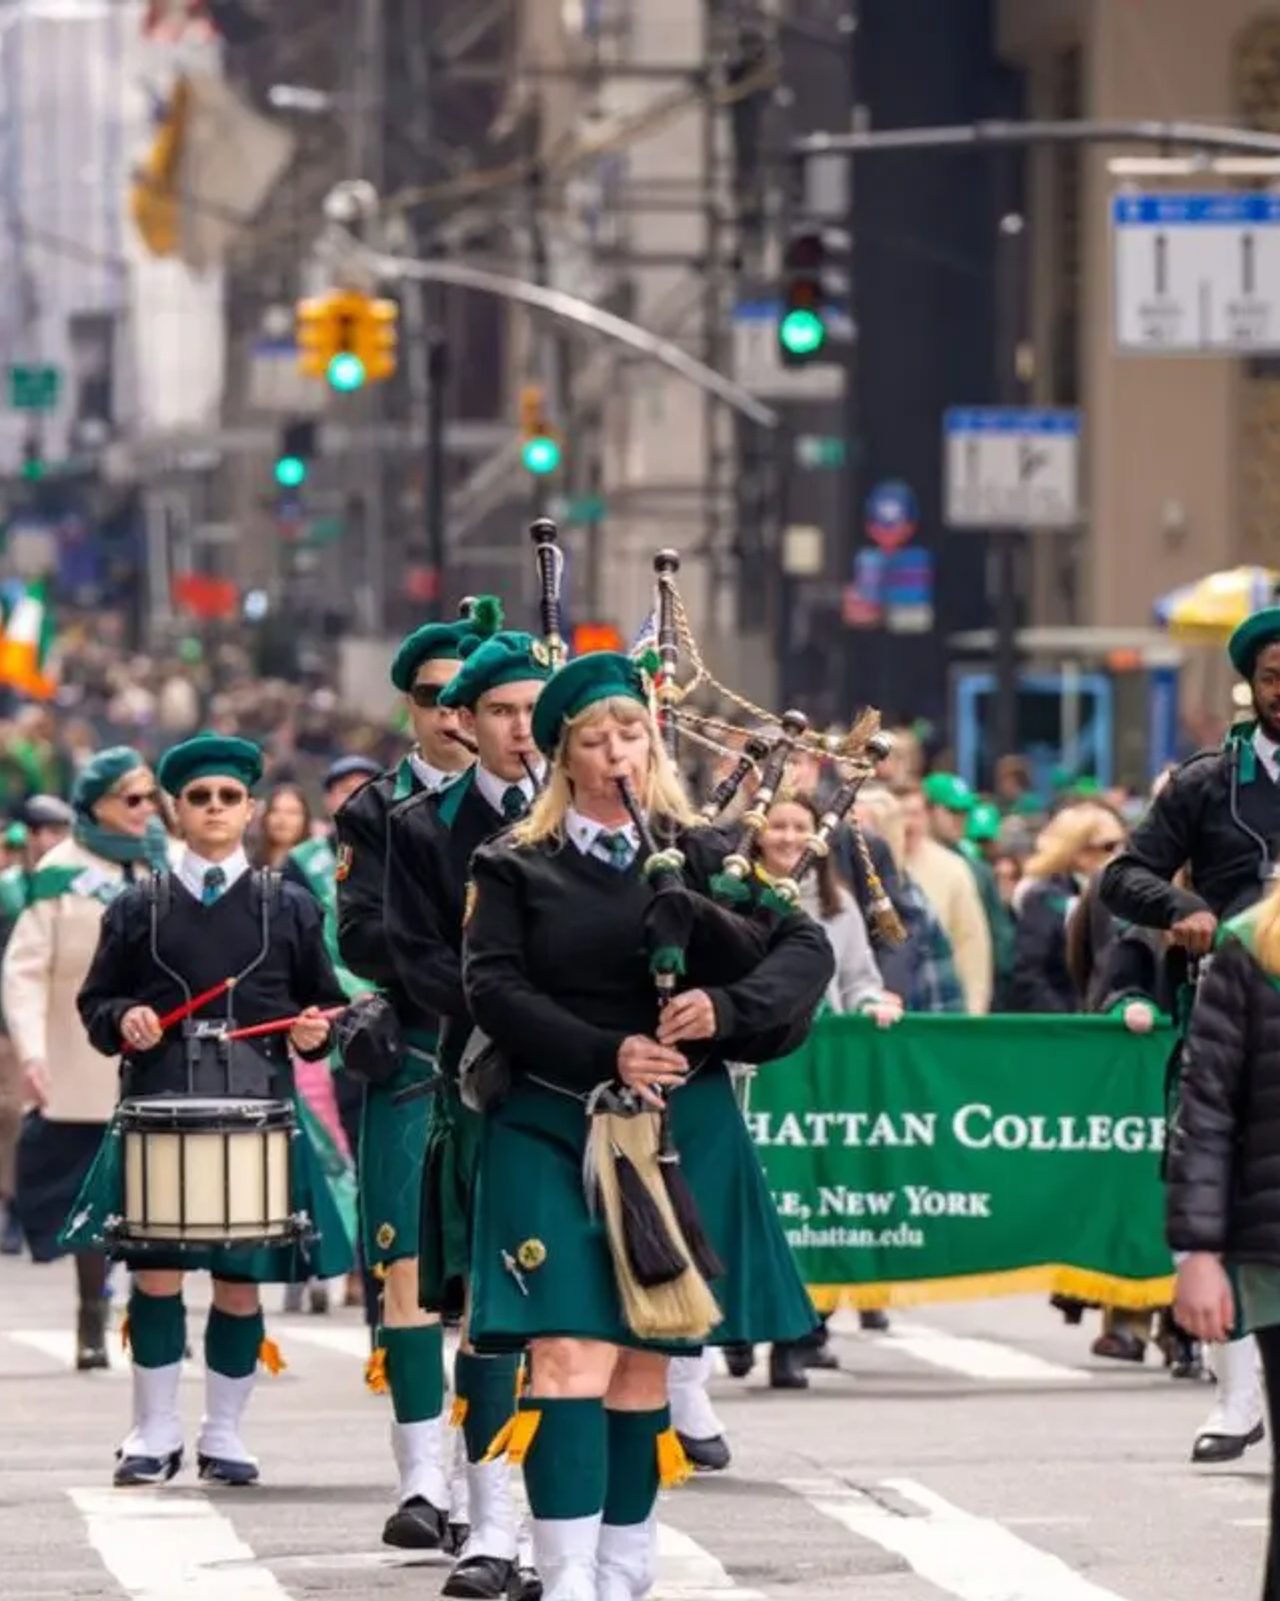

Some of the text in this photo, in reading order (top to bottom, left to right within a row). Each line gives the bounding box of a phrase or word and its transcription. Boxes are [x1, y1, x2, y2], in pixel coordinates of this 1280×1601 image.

[952, 1103, 1166, 1152] COLLEGE
[817, 1186, 896, 1217] NEW
[903, 1184, 991, 1217] YORK
